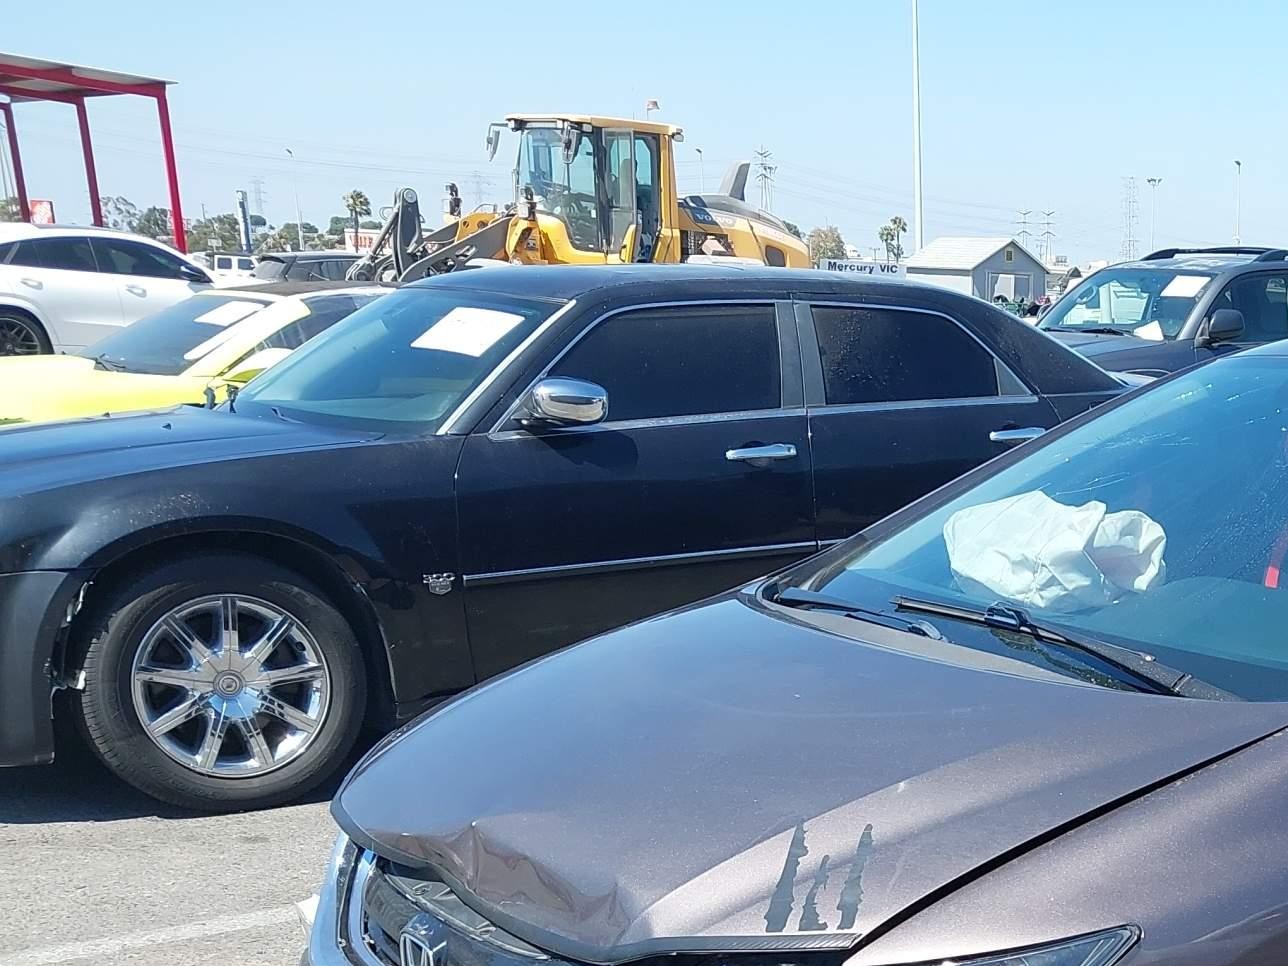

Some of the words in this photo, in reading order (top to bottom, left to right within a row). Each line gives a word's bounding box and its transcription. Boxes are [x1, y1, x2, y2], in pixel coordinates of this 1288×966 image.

[695, 212, 733, 225] VOVO
[828, 261, 874, 274] Mercury
[879, 264, 898, 274] VIC
